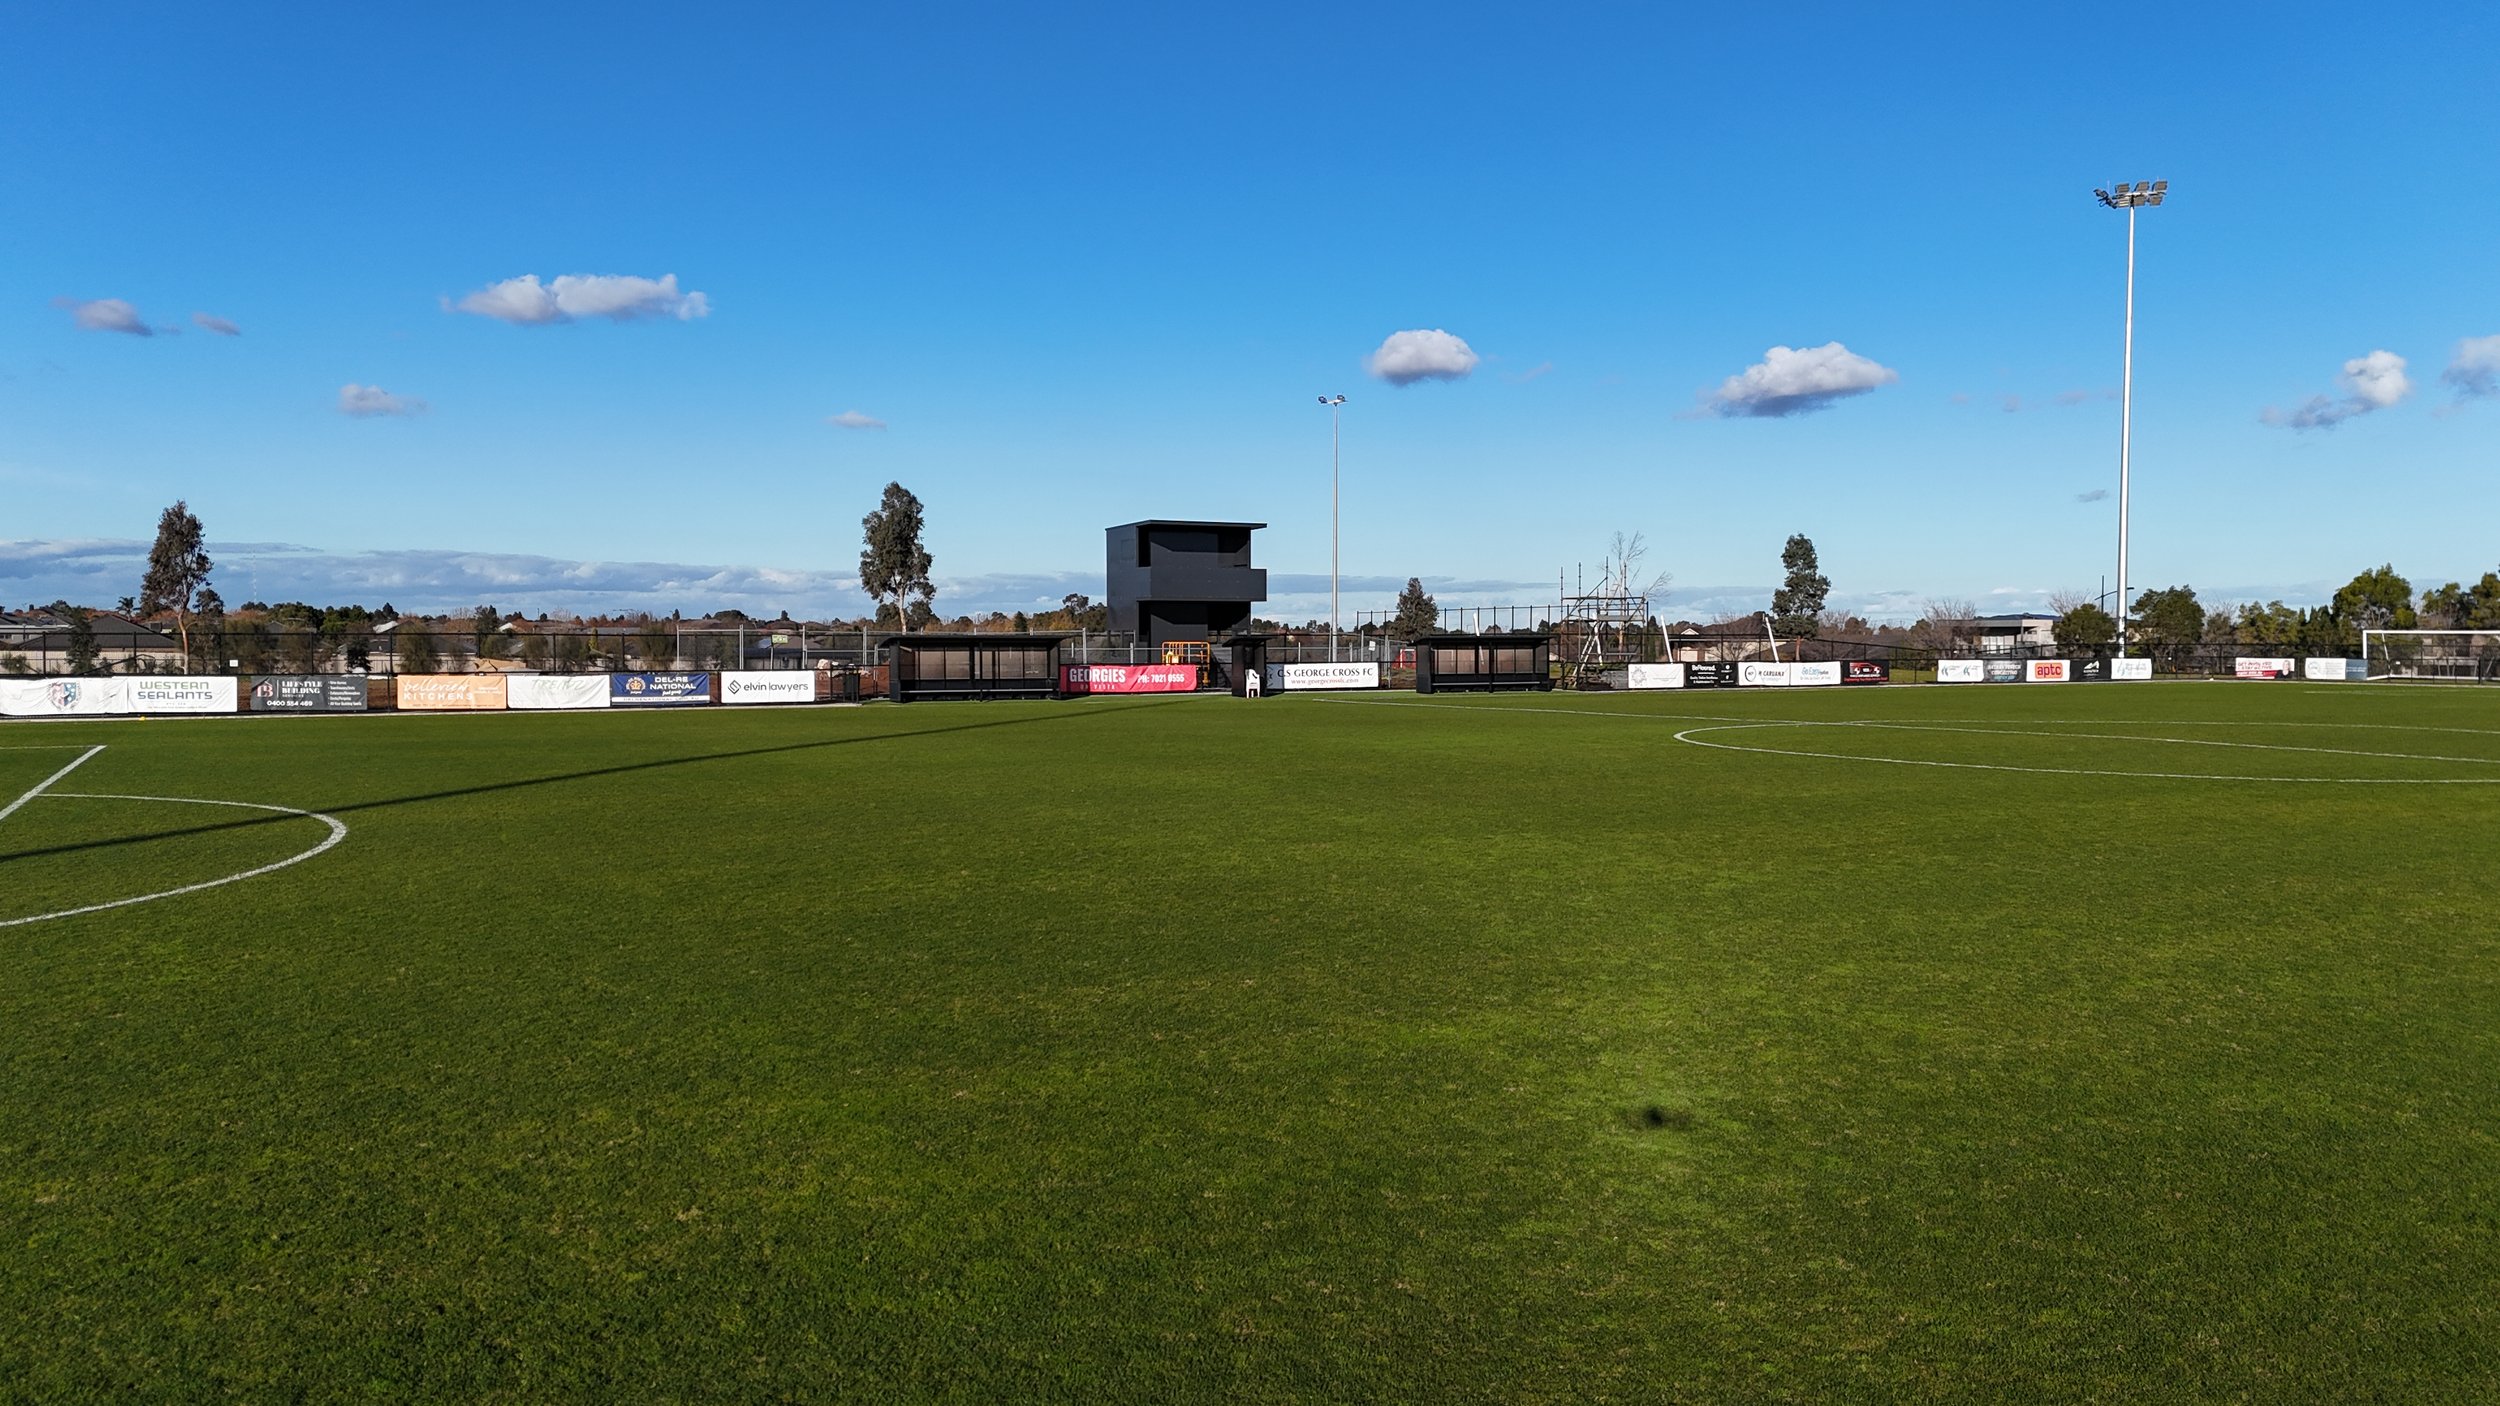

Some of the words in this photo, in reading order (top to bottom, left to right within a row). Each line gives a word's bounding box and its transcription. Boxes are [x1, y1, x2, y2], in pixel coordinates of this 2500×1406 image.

[1294, 669, 1330, 677] GEORGE
[1333, 668, 1360, 677] CROSS
[1363, 668, 1373, 676] FC
[2037, 664, 2062, 678] aptc
[1070, 669, 1126, 683] GEORGIES
[1151, 674, 1167, 683] 7021
[1168, 673, 1185, 683] 0555
[140, 681, 209, 690] WESTERN
[743, 682, 767, 691] elvin
[769, 682, 809, 692] lawyers
[137, 691, 213, 700] SEALANTS
[403, 693, 473, 701] KITCHENS
